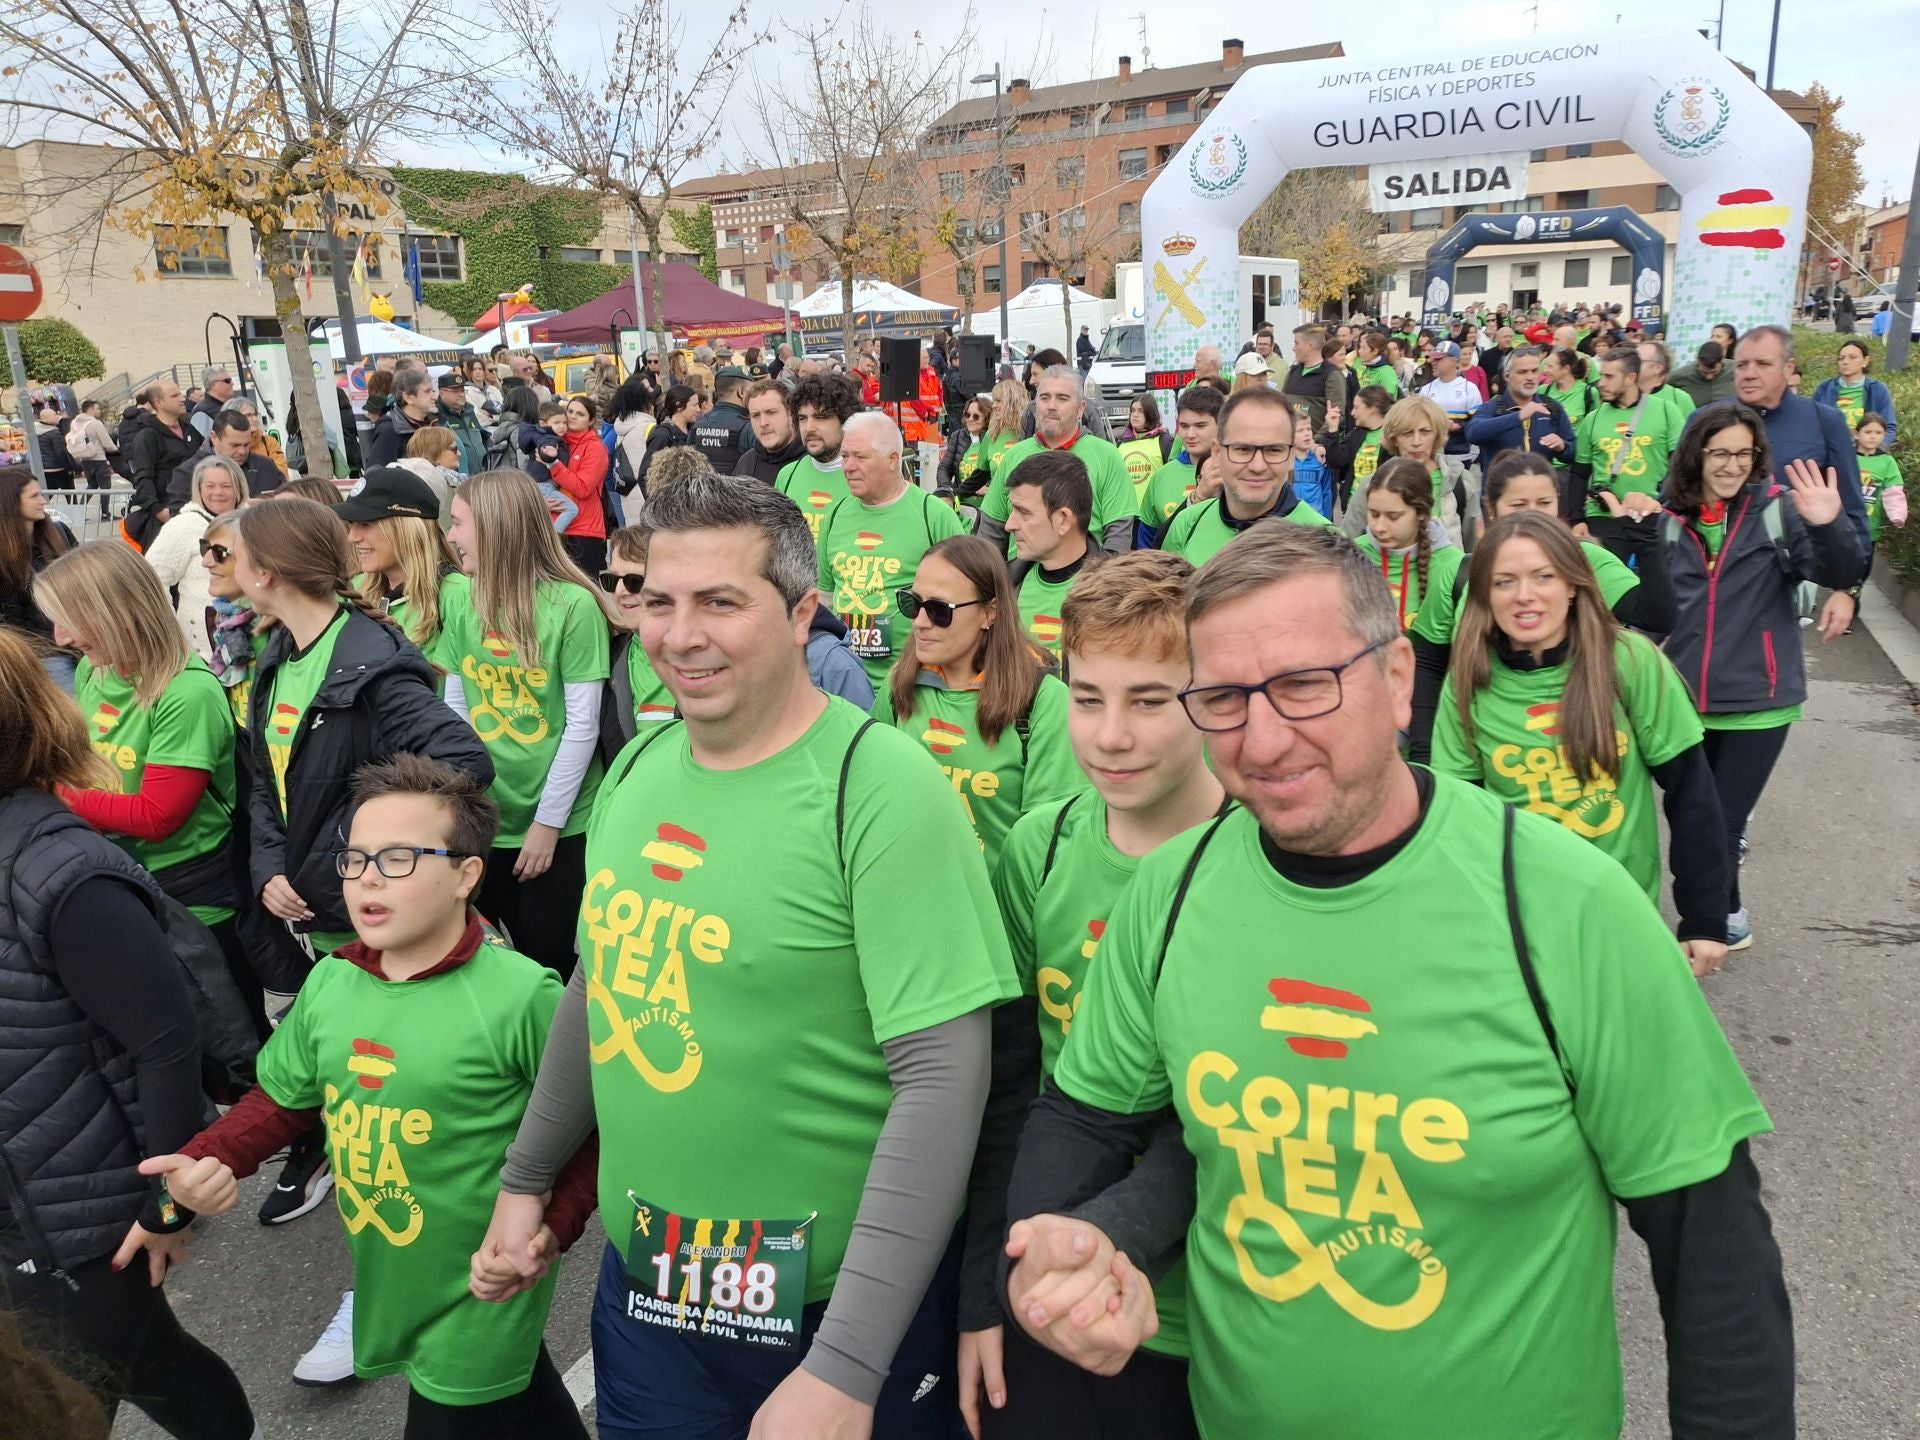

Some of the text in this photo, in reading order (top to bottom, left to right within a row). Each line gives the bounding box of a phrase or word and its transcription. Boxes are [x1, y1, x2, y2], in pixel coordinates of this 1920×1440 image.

[1318, 43, 1599, 88] JUNTA CENTRAL DE EDUCACIÓN
[1368, 71, 1536, 104] FÍSICA Y DEPORTES
[1314, 94, 1596, 148] GUARDIA CIVIL
[1190, 186, 1226, 200] GUARDIA
[1383, 165, 1512, 200] SALIDA
[1539, 216, 1573, 232] FFD
[894, 310, 943, 324] GUARDIA CIVIL
[1423, 312, 1448, 325] FFD
[1633, 304, 1660, 318] FFD
[696, 428, 729, 437] GUARDIA
[702, 438, 721, 447] CIVIL
[1599, 435, 1652, 450] Core
[832, 552, 900, 574] Corre
[841, 569, 885, 590] TEA
[850, 629, 882, 646] 373
[462, 654, 548, 688] Corre
[476, 681, 540, 708] TEA
[583, 868, 731, 963] Corre
[588, 924, 691, 1013] TEA
[632, 1007, 700, 1055] AUTISMO
[325, 1083, 433, 1145] Corre
[1186, 1050, 1469, 1163] Corre
[330, 1130, 410, 1187] TEA
[1216, 1125, 1424, 1231] TEA
[369, 1187, 421, 1215] AUTISMO
[680, 1242, 747, 1258] ALEXANDRU
[1329, 1224, 1445, 1277] AUTISMO
[651, 1251, 777, 1313] 1188
[635, 1293, 702, 1319] CARRERA
[706, 1307, 794, 1333] SOLIDARIA
[634, 1309, 791, 1346] GUARDIA CIVIL LA RIOJ
